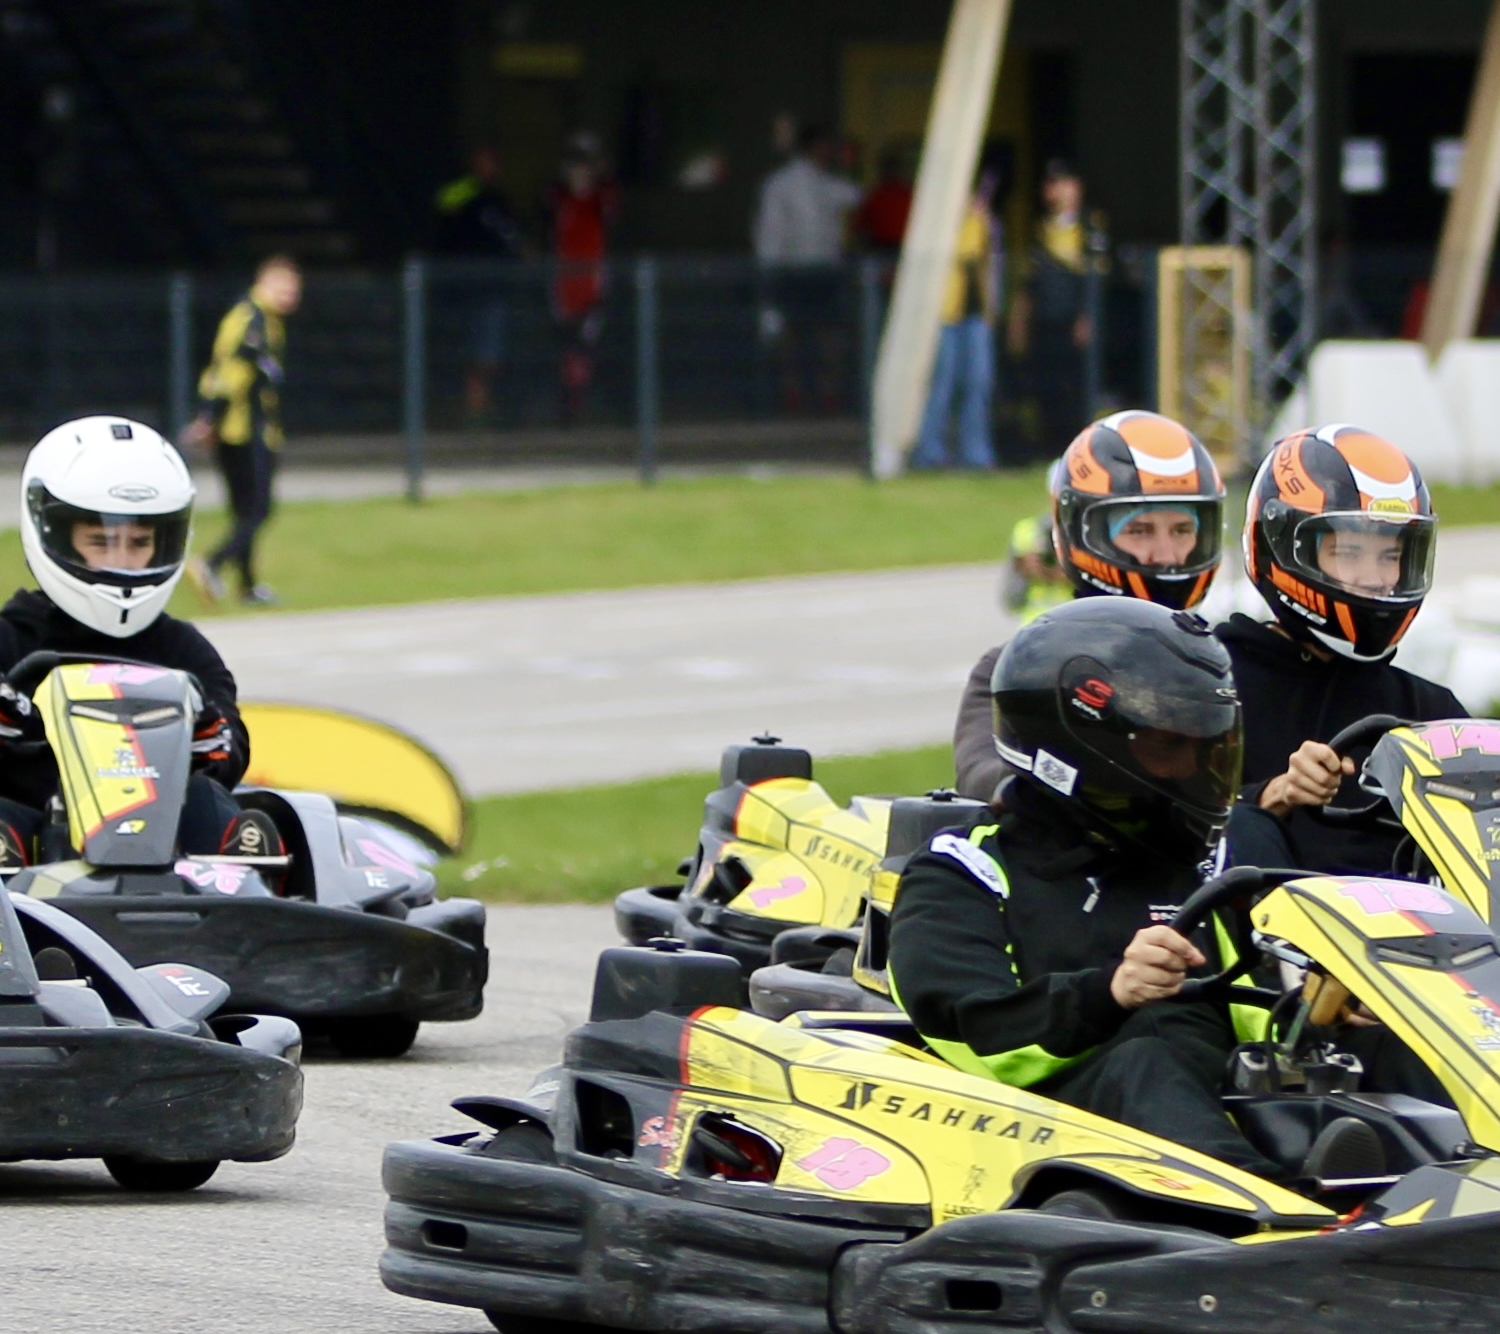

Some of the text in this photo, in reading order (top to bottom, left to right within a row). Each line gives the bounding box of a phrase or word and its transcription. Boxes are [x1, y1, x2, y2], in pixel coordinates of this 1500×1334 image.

[748, 875, 807, 908] 2
[881, 1095, 1055, 1146] SAHKAR
[797, 1136, 891, 1190] 18
